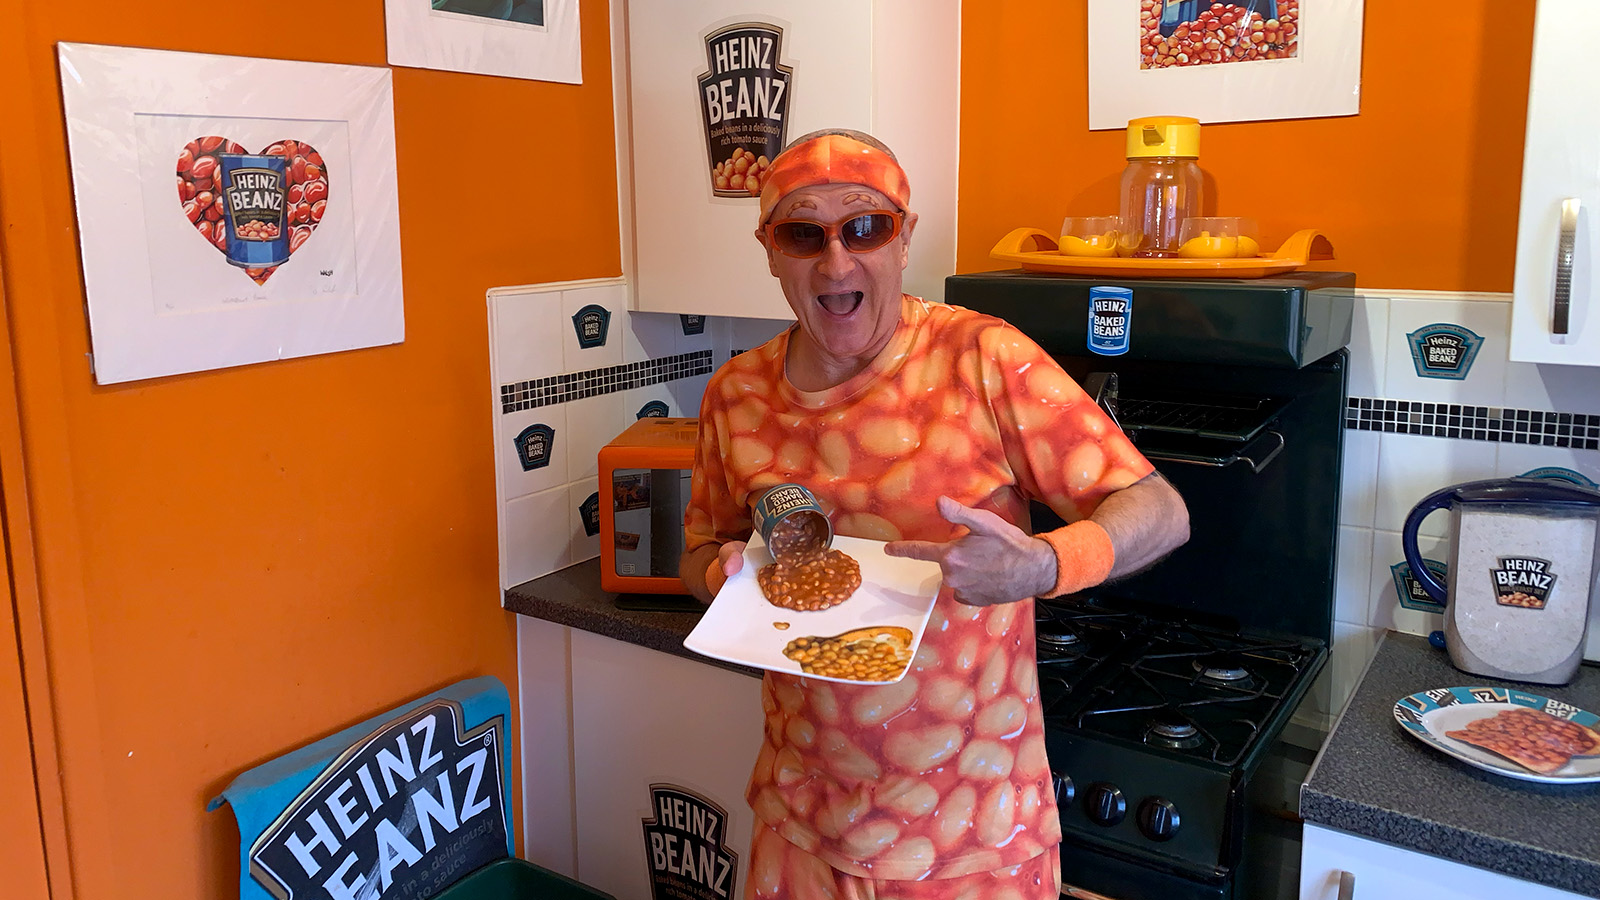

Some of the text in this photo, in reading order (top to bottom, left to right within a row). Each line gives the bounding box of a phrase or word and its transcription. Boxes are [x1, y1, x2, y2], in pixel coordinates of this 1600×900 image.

[715, 37, 773, 74] HEINZ
[705, 77, 785, 125] BEANZ
[725, 125, 741, 134] beans
[742, 123, 748, 131] in
[721, 135, 768, 145] rich tomato sauce
[237, 174, 277, 190] HEINZ
[231, 190, 283, 211] BEANZ
[1095, 301, 1126, 313] HEINZ
[1094, 315, 1125, 327] BAKED
[1093, 325, 1125, 337] BEANS
[1430, 336, 1458, 347] Heinz
[1429, 347, 1457, 357] BAKED
[1429, 355, 1457, 364] BEANZ
[770, 488, 800, 501] BEANS
[773, 493, 803, 507] BAKED
[776, 498, 810, 514] HEINZ
[1505, 559, 1545, 573] HEINZ
[1496, 570, 1552, 590] BEANZ
[1412, 587, 1430, 597] BEA
[284, 714, 443, 879] HEINZ
[322, 748, 491, 900] EANZ
[660, 796, 718, 845] HEINZ
[431, 819, 494, 871] deliciously
[433, 854, 467, 888] sauce
[650, 832, 731, 898] BEANZ
